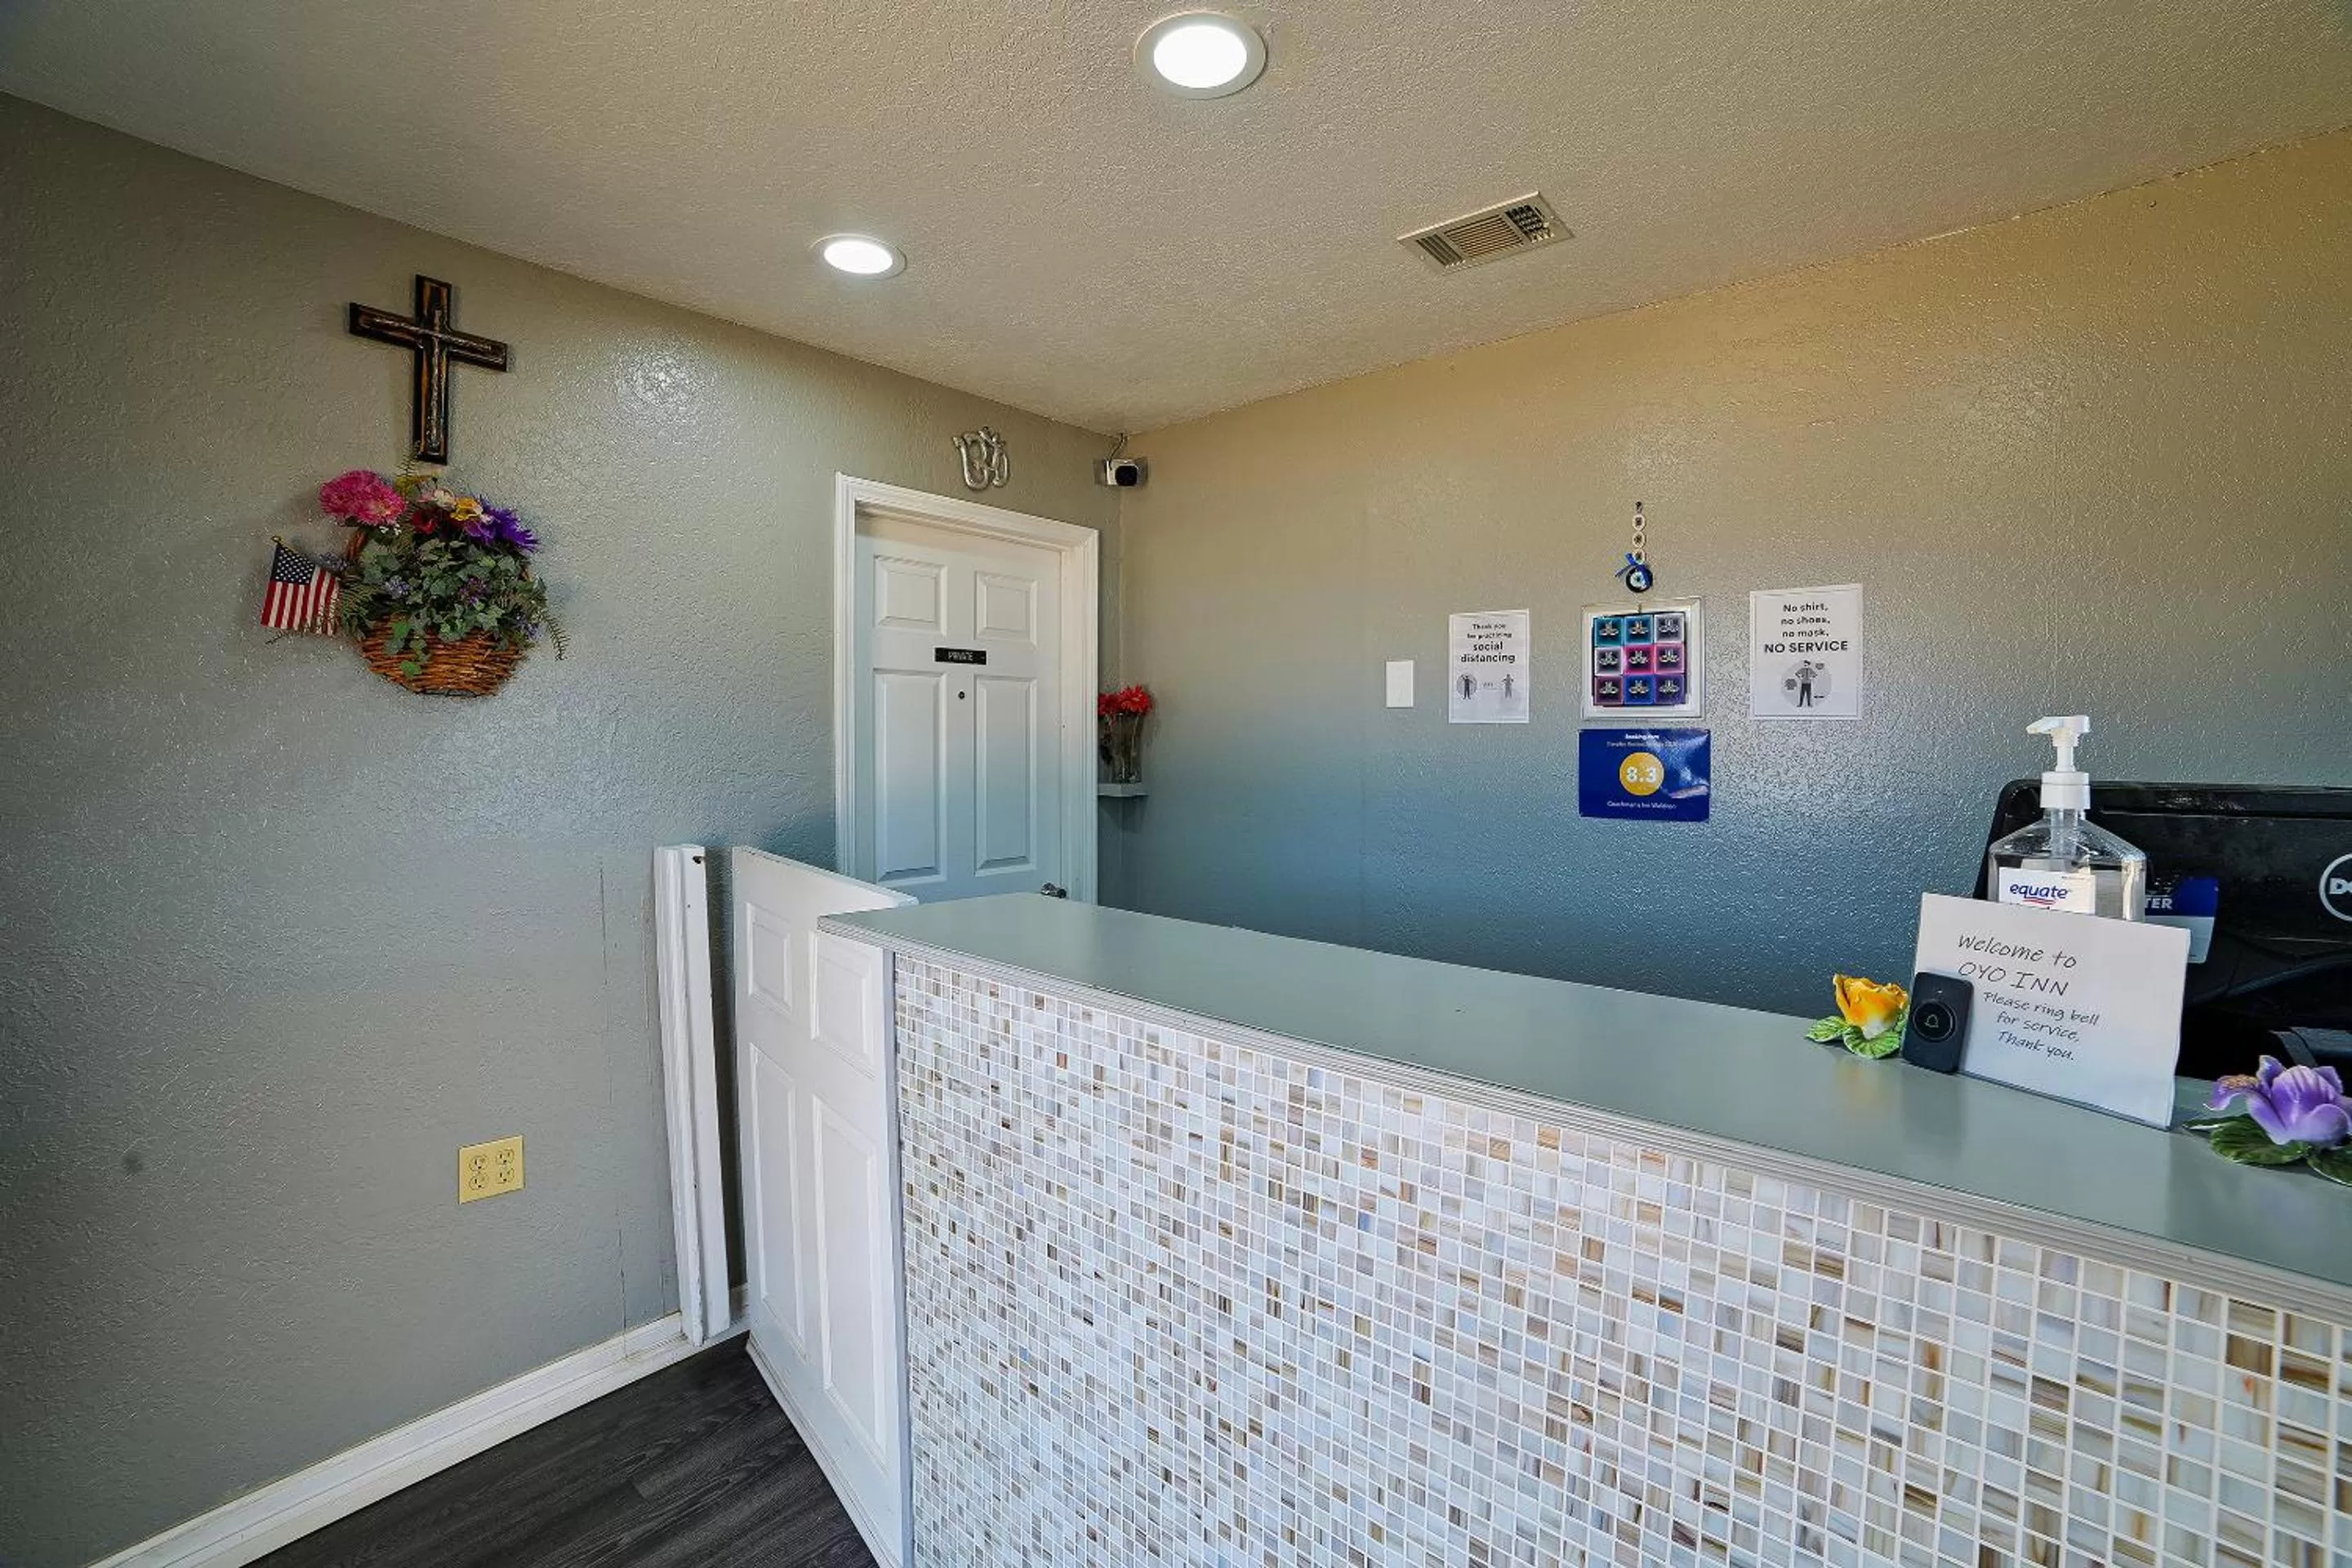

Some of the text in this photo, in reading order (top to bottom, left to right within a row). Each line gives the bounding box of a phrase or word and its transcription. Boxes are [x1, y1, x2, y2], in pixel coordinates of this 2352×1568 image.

[1783, 602, 1829, 612] No shirt,
[1797, 616, 1831, 625] shoes,
[1797, 628, 1829, 638] mask,
[1472, 640, 1503, 652] social
[1764, 640, 1849, 654] NO SERVICE
[1460, 652, 1516, 664] distancing
[1626, 766, 1657, 783] 8.3
[2009, 884, 2069, 899] equate
[1958, 934, 2078, 968] Welcome to
[1958, 961, 2069, 996] OYO INN
[1983, 991, 2100, 1027] Please ring bell
[1996, 1010, 2020, 1024] for
[1998, 1030, 2074, 1061] Thank you.
